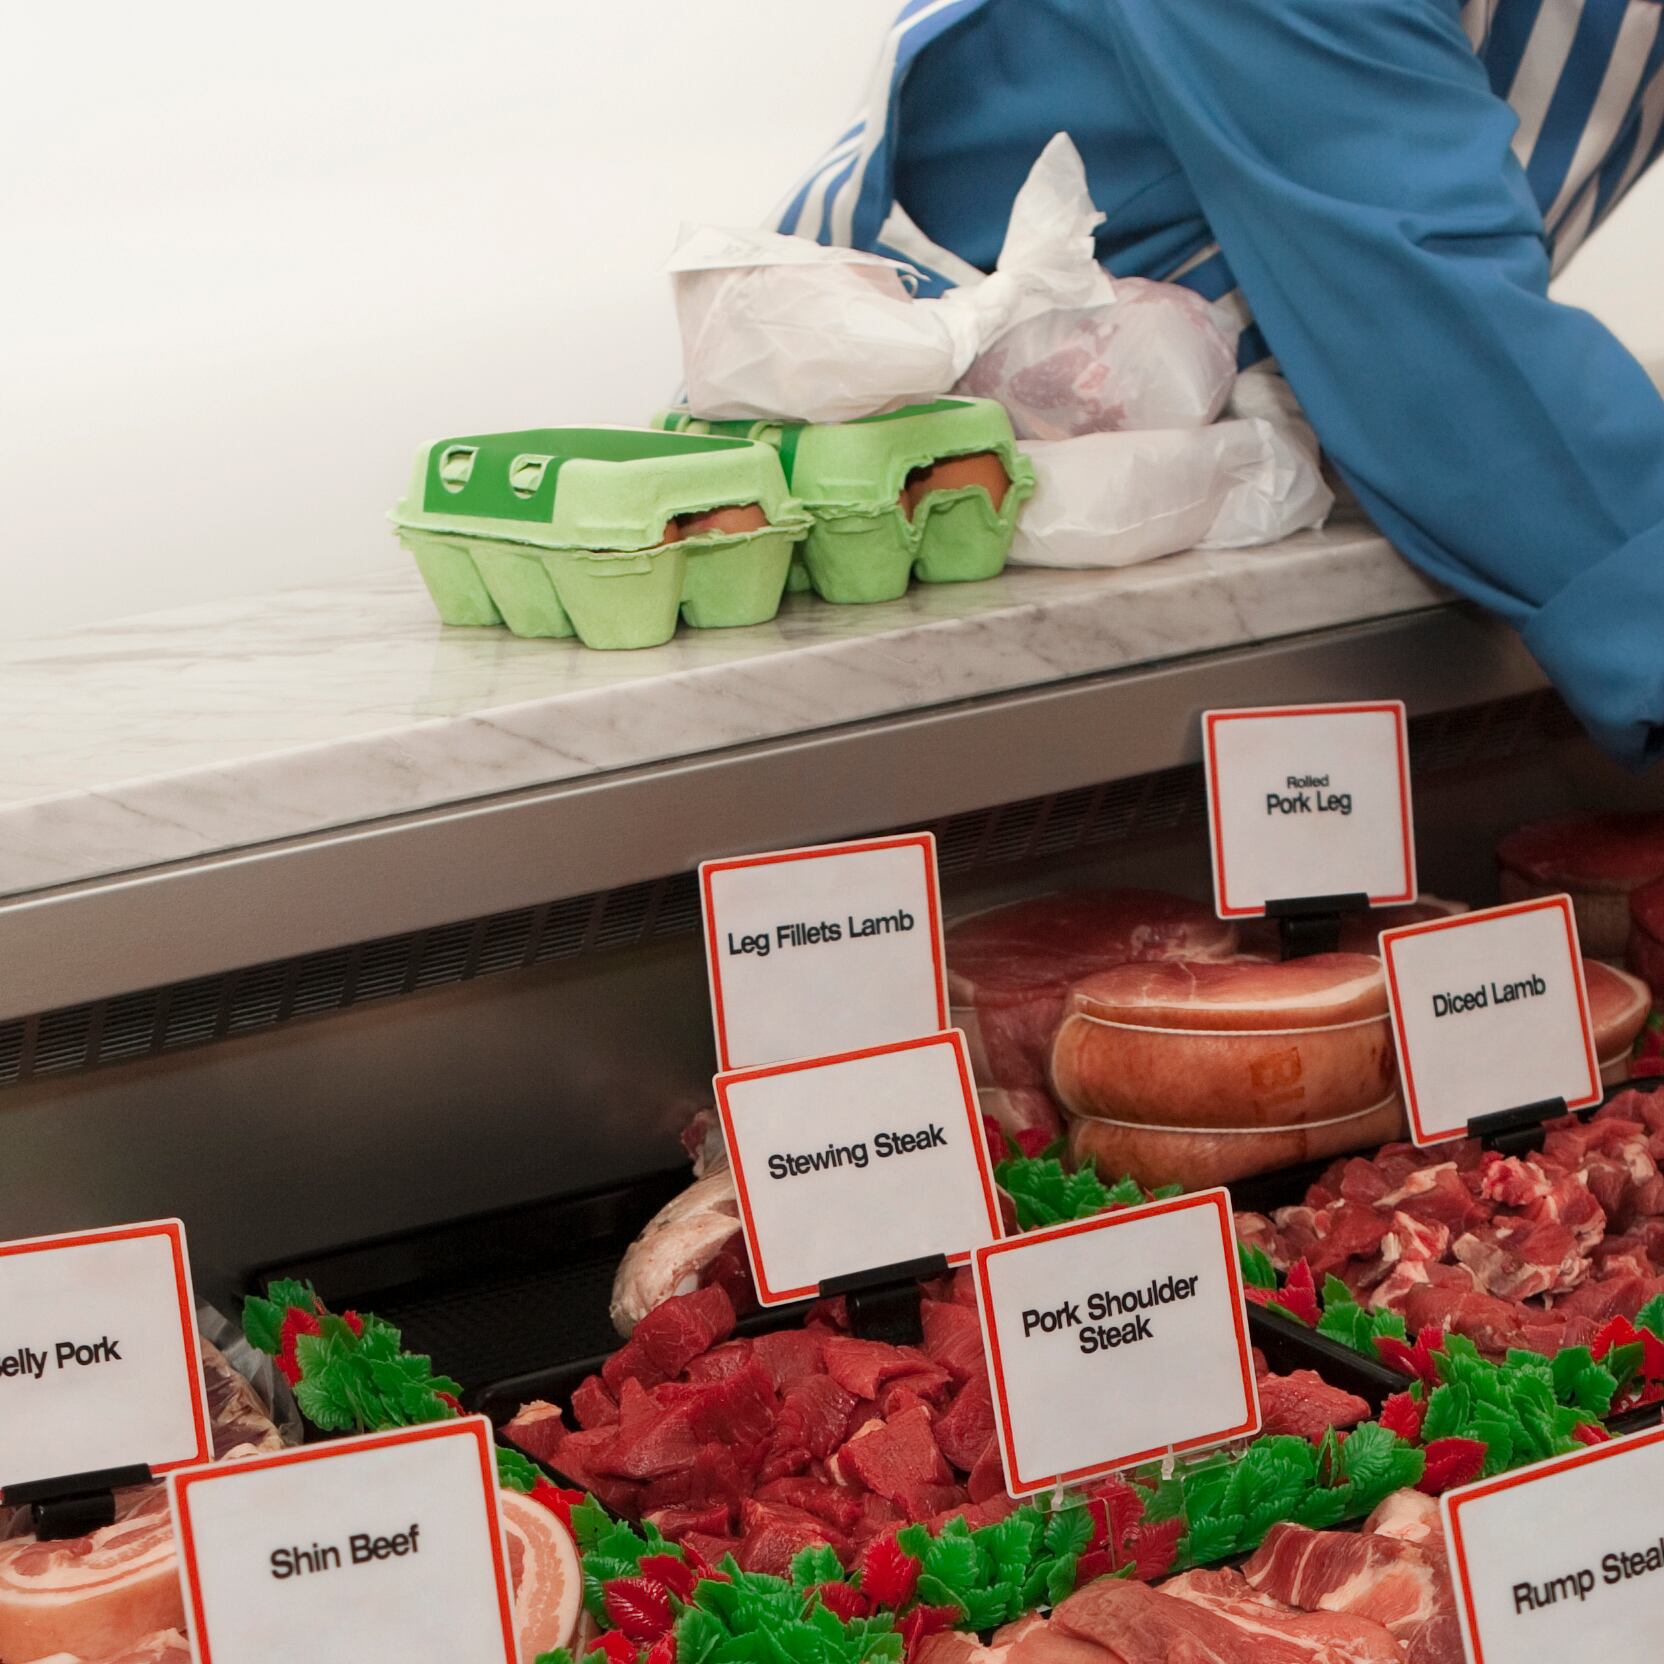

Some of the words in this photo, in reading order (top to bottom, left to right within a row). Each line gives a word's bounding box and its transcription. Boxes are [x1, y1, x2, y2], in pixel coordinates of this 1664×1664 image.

[1266, 791, 1312, 816] Pork
[1316, 790, 1353, 816] Leg
[1286, 774, 1330, 789] Rolled
[727, 931, 772, 957] Leg
[776, 921, 844, 949] Fillets
[847, 908, 916, 939] Lamb
[1432, 984, 1490, 1018] Diced
[1490, 973, 1547, 1006] Lamb
[767, 1142, 870, 1180] Stewing
[873, 1123, 949, 1159] Steak
[1021, 1299, 1084, 1338] Pork
[1087, 1274, 1200, 1322] Shoulder
[54, 1335, 123, 1369] Pork
[1078, 1314, 1155, 1354] Steak
[269, 1542, 342, 1580] Shin
[348, 1523, 420, 1565] Beef
[1512, 1568, 1596, 1615] Rump
